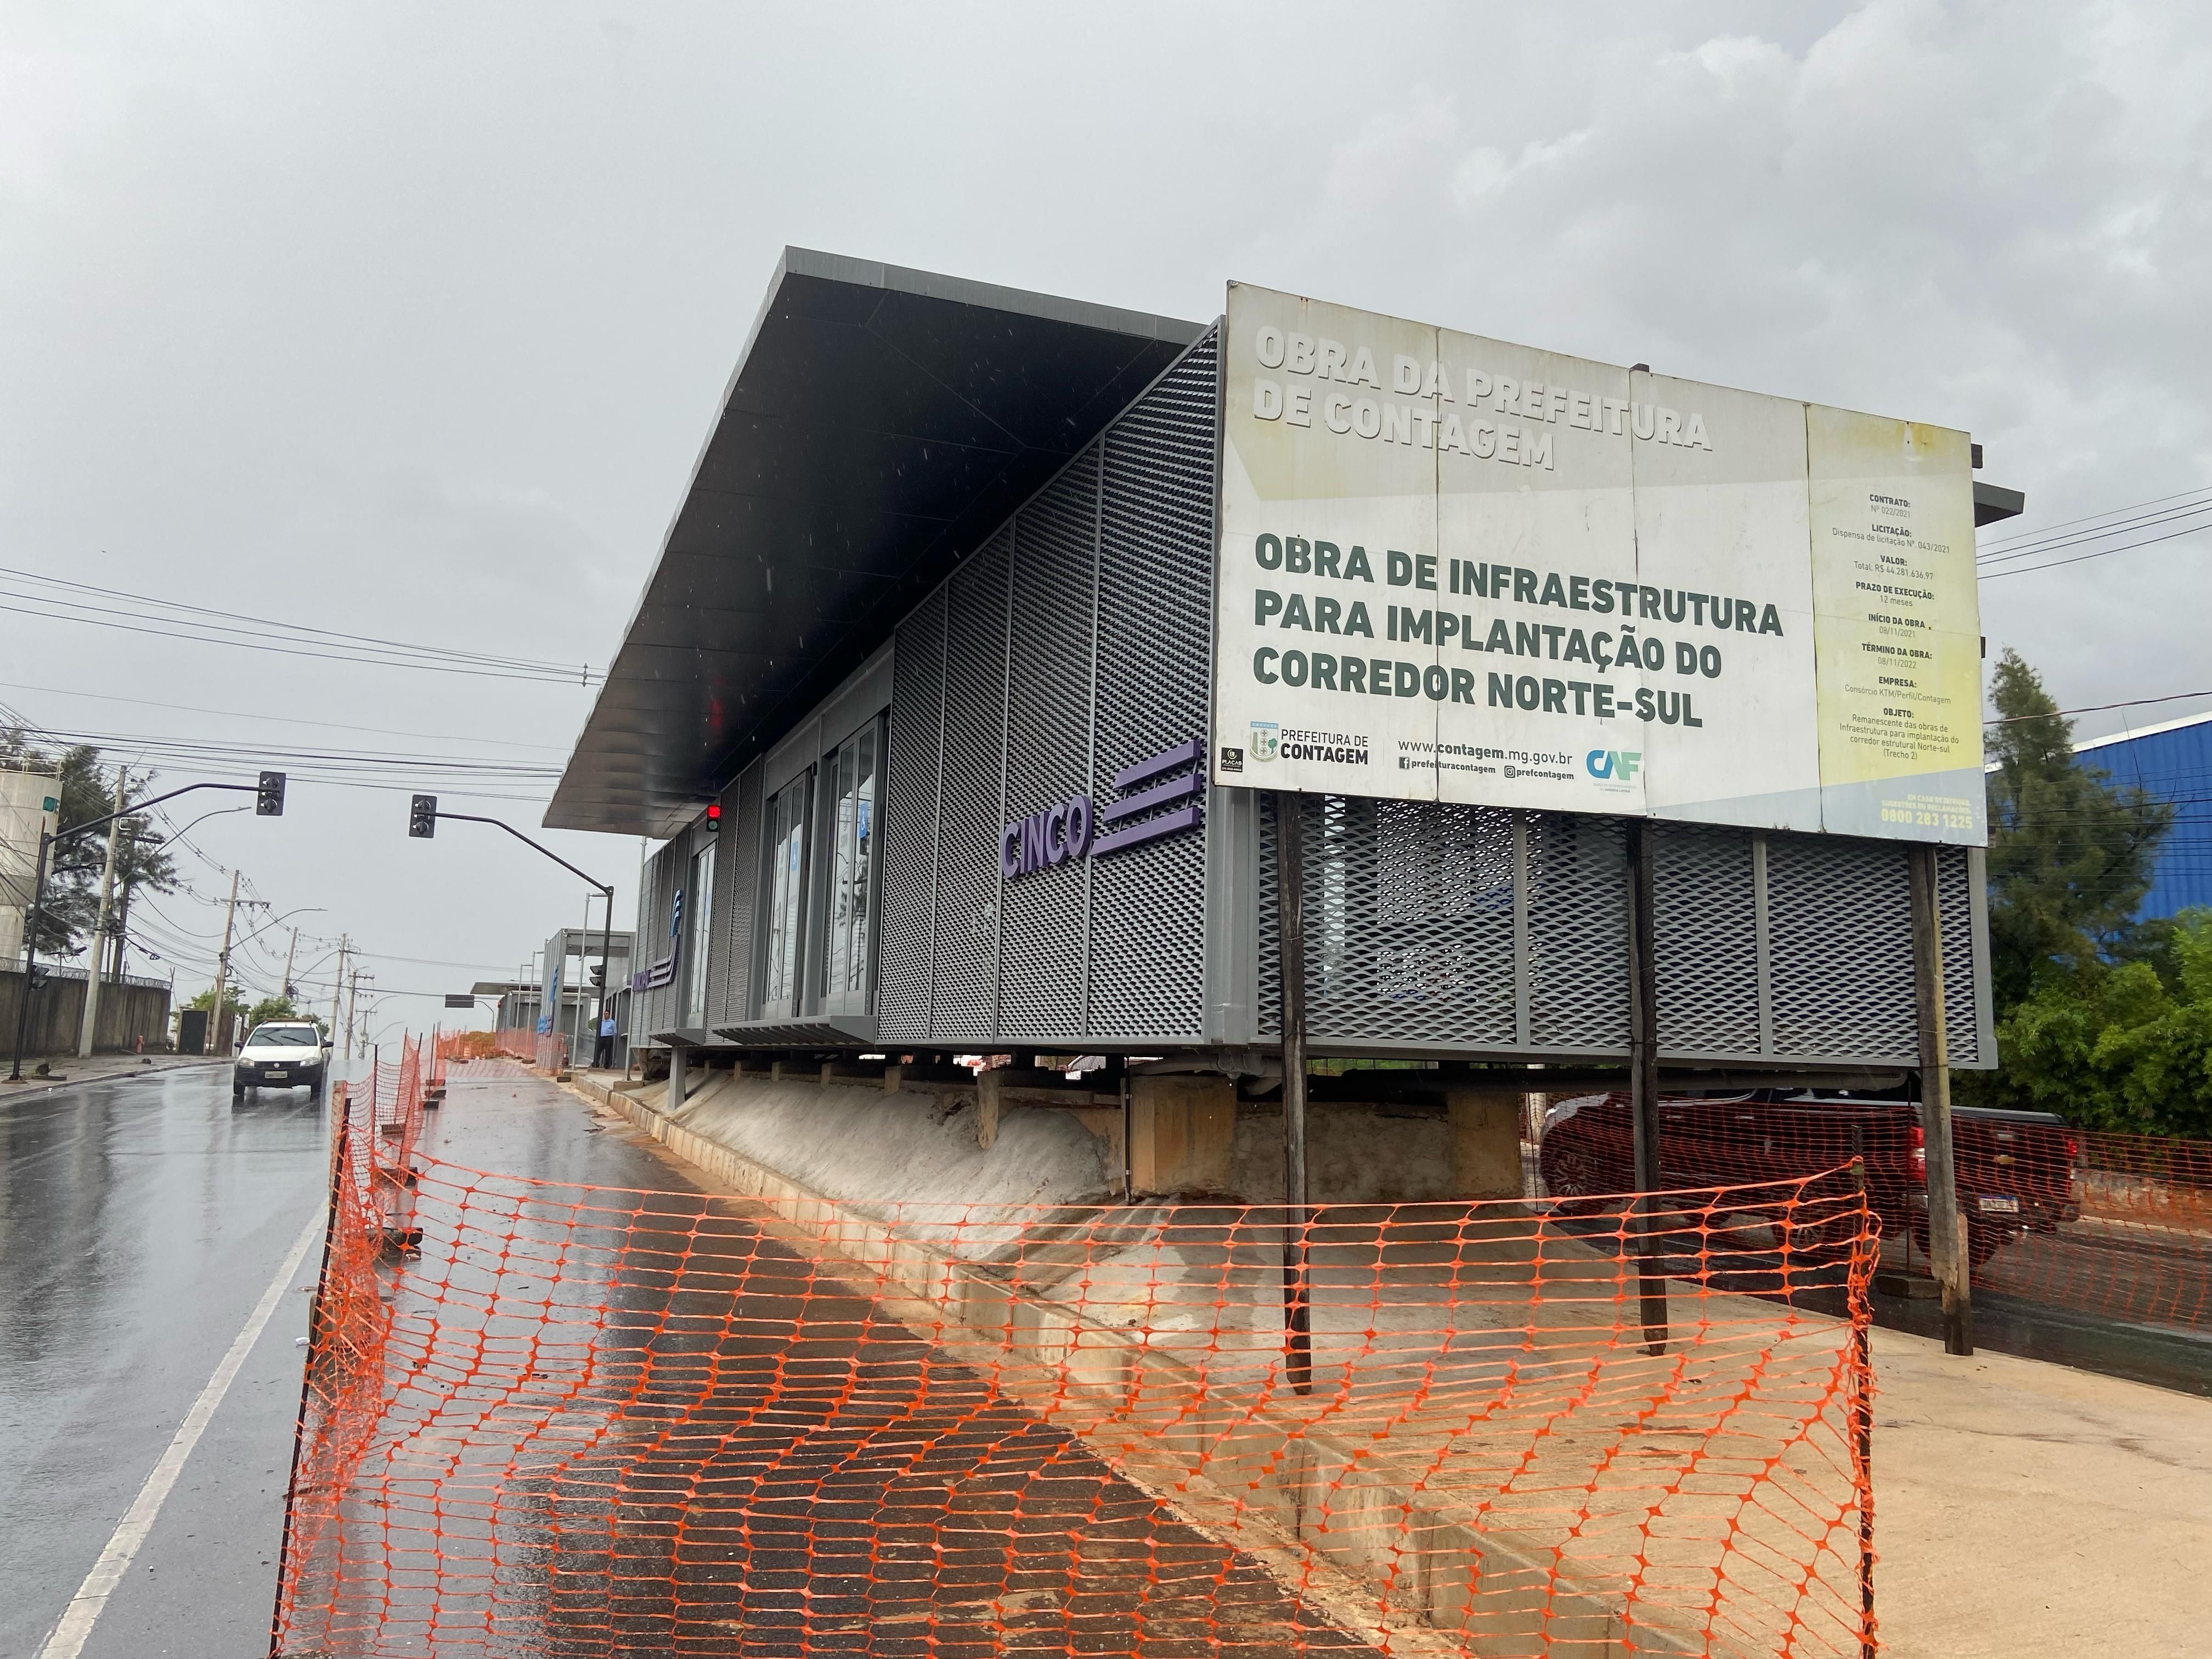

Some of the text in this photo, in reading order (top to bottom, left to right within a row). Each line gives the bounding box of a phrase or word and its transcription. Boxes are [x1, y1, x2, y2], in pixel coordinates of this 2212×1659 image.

[1255, 325, 1713, 452] OBRA DA PREFEITURA
[1254, 379, 1554, 472] DE CONTAGEM
[1870, 494, 1910, 507] CONTRATO:
[1882, 506, 1910, 518] 022/2021
[1872, 524, 1911, 537] LICITAÇÃO:
[1832, 528, 1864, 540] Dispensa
[1877, 535, 1905, 546] licitação
[1918, 541, 1949, 553] 043/2021
[1875, 564, 1884, 572] R$
[1880, 555, 1908, 566] VALOR:
[1255, 533, 1784, 637] OBRA DE INFRAESTRUTURA
[1856, 582, 1935, 600] PRAZO DE EXECUÇÃO:
[1891, 598, 1913, 606] meses
[1868, 613, 1891, 623] INÍCIO
[1893, 617, 1903, 625] DA
[1254, 589, 1722, 679] PARA IMPLANTAÇÃO DO
[1880, 626, 1915, 637] 08/11/2021
[1861, 642, 1932, 659] TÉRMINO DA OBRA:
[1878, 657, 1916, 669] 08/11/2022
[1253, 647, 1703, 728] CORREDOR NORTE-SUL
[1878, 676, 1917, 688] EMPRESA:
[1845, 684, 1951, 704] Consórcio KTM/Perfil/Contagem
[1883, 708, 1914, 718] OBJETO:
[1853, 714, 1948, 732] Remanescente das obras de
[1282, 729, 1368, 747] PREFEITURA DE
[1839, 723, 1888, 736] Infraestrutura
[1907, 731, 1948, 743] implantação
[1951, 735, 1959, 743] do
[1398, 741, 1573, 765] www.contagem.mg.gov.br
[1850, 736, 1950, 753] corredor estrutural Norte-sul
[1280, 743, 1368, 765] CONTAGEM
[1883, 749, 1917, 760] (Trecho 2)
[1412, 760, 1496, 774] prefeituracontagem
[1517, 769, 1574, 780] prefcontagem
[1881, 808, 1973, 830] 0800 283 1225
[1002, 795, 1092, 878] CINCO
